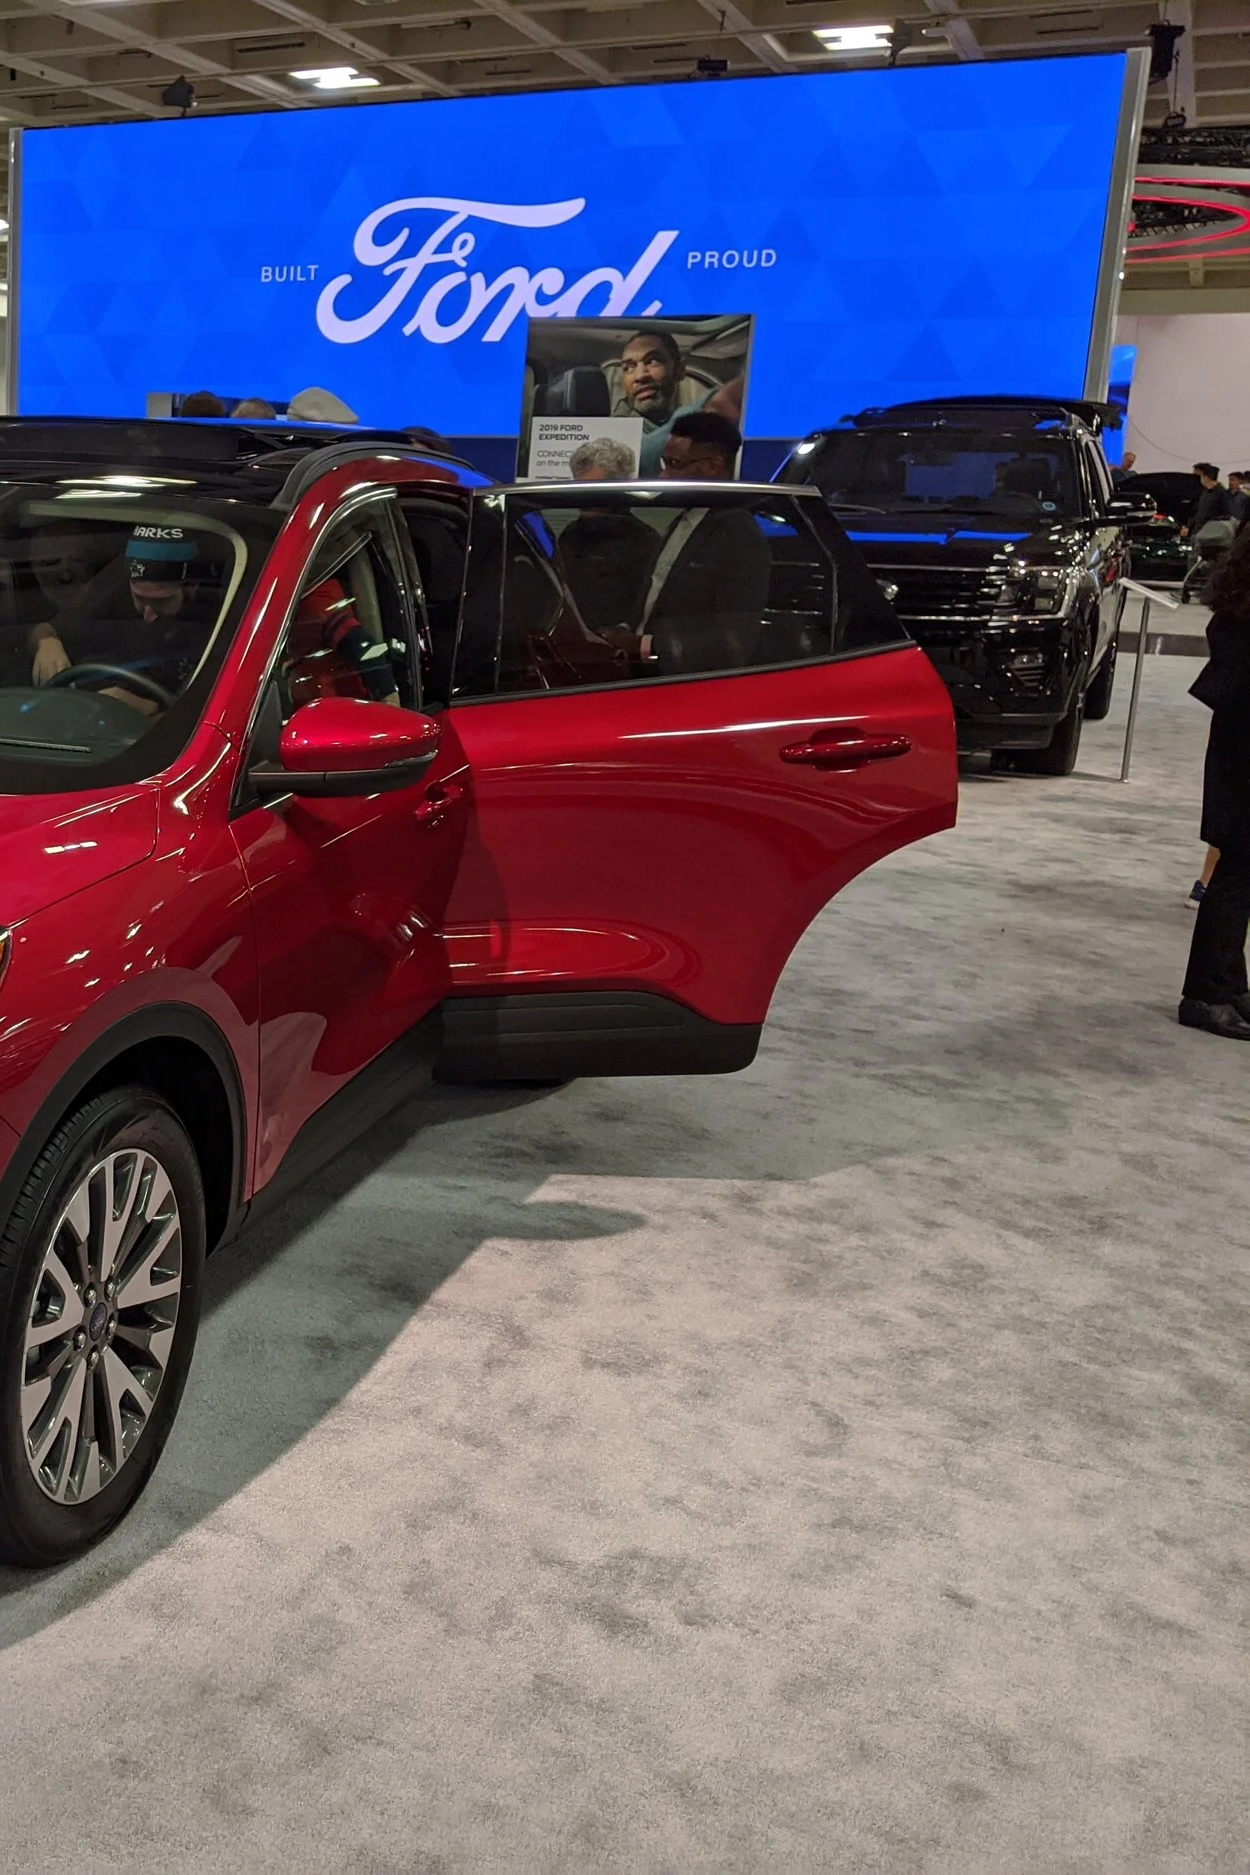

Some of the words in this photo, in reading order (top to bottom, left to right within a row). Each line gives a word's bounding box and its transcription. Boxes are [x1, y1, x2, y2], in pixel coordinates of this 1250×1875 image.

[260, 264, 319, 282] BUILT
[686, 249, 777, 270] PROUD
[539, 424, 559, 432] 2019
[559, 424, 584, 432] FORD
[538, 433, 590, 441] EXPEDITION
